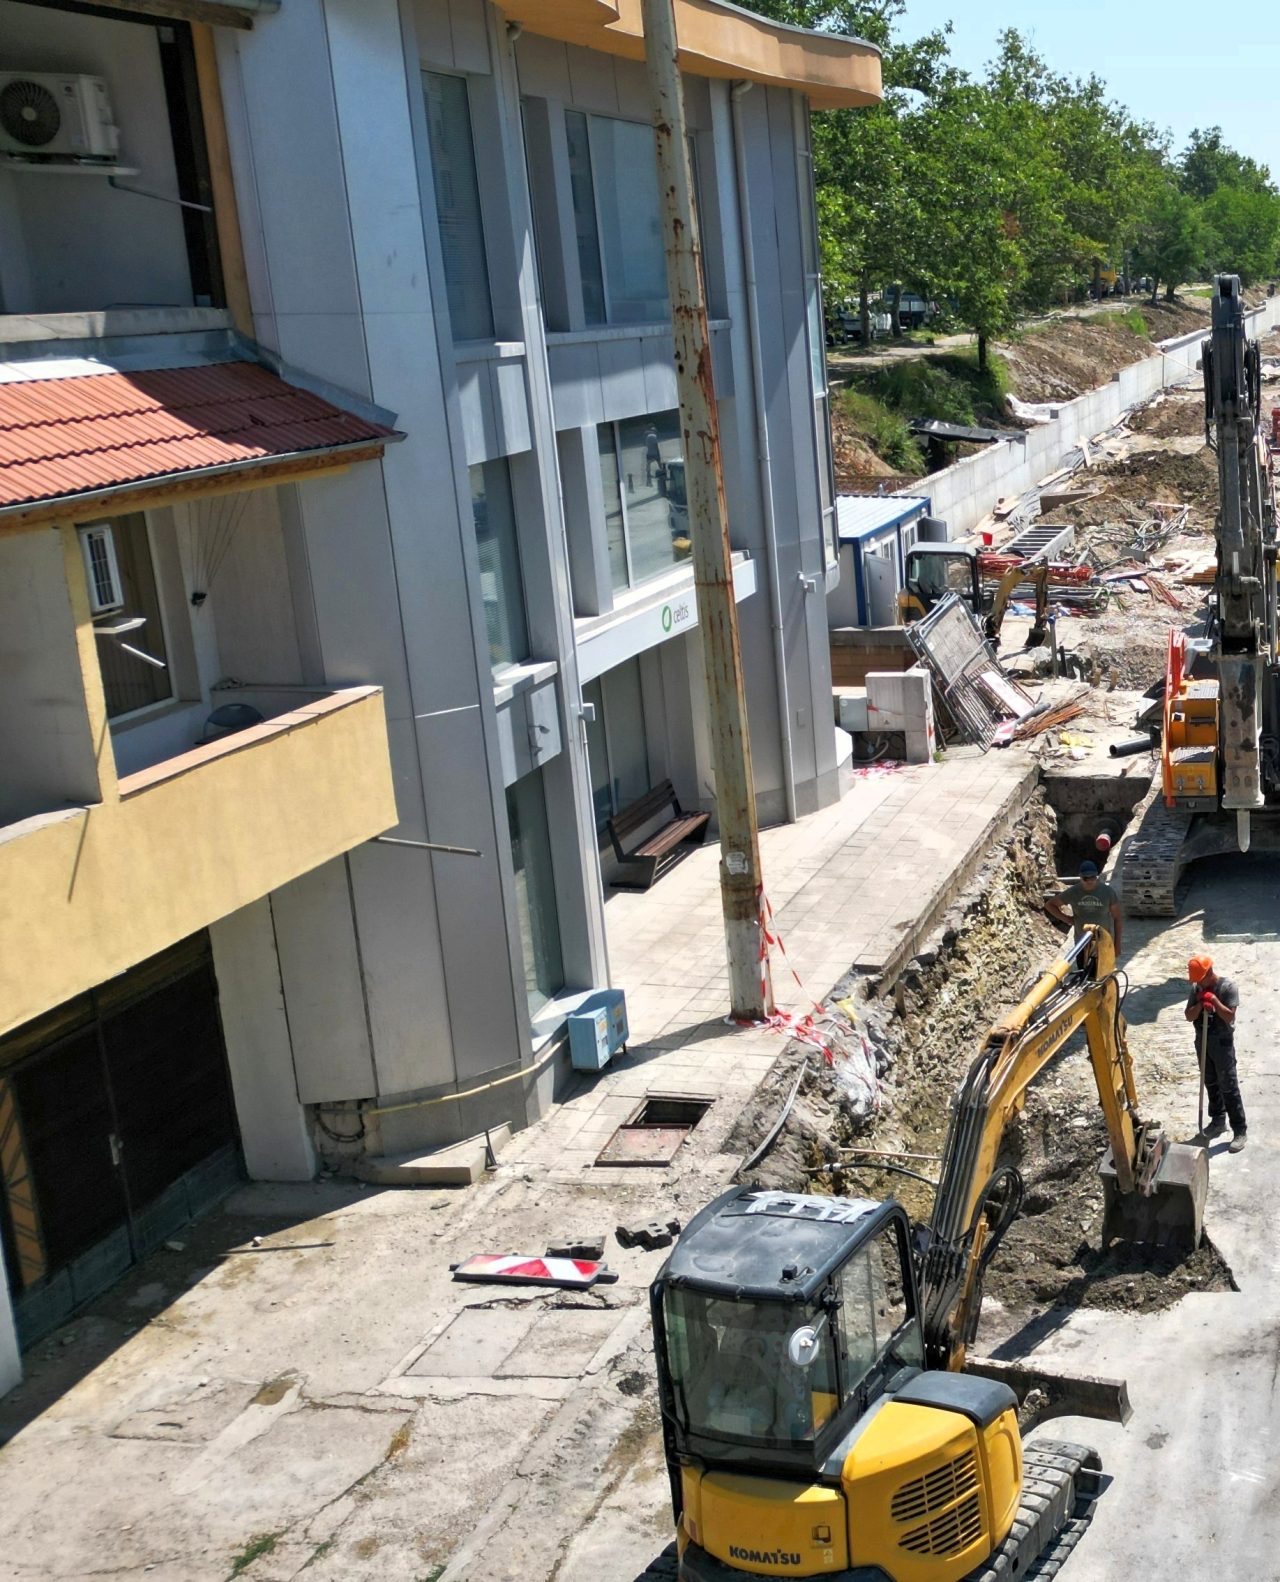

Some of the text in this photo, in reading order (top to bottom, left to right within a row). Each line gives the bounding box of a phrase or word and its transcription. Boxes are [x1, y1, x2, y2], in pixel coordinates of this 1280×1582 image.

[673, 602, 689, 624] celtis
[1037, 1014, 1073, 1057] KOMATSU
[729, 1545, 801, 1565] KOMATSU
